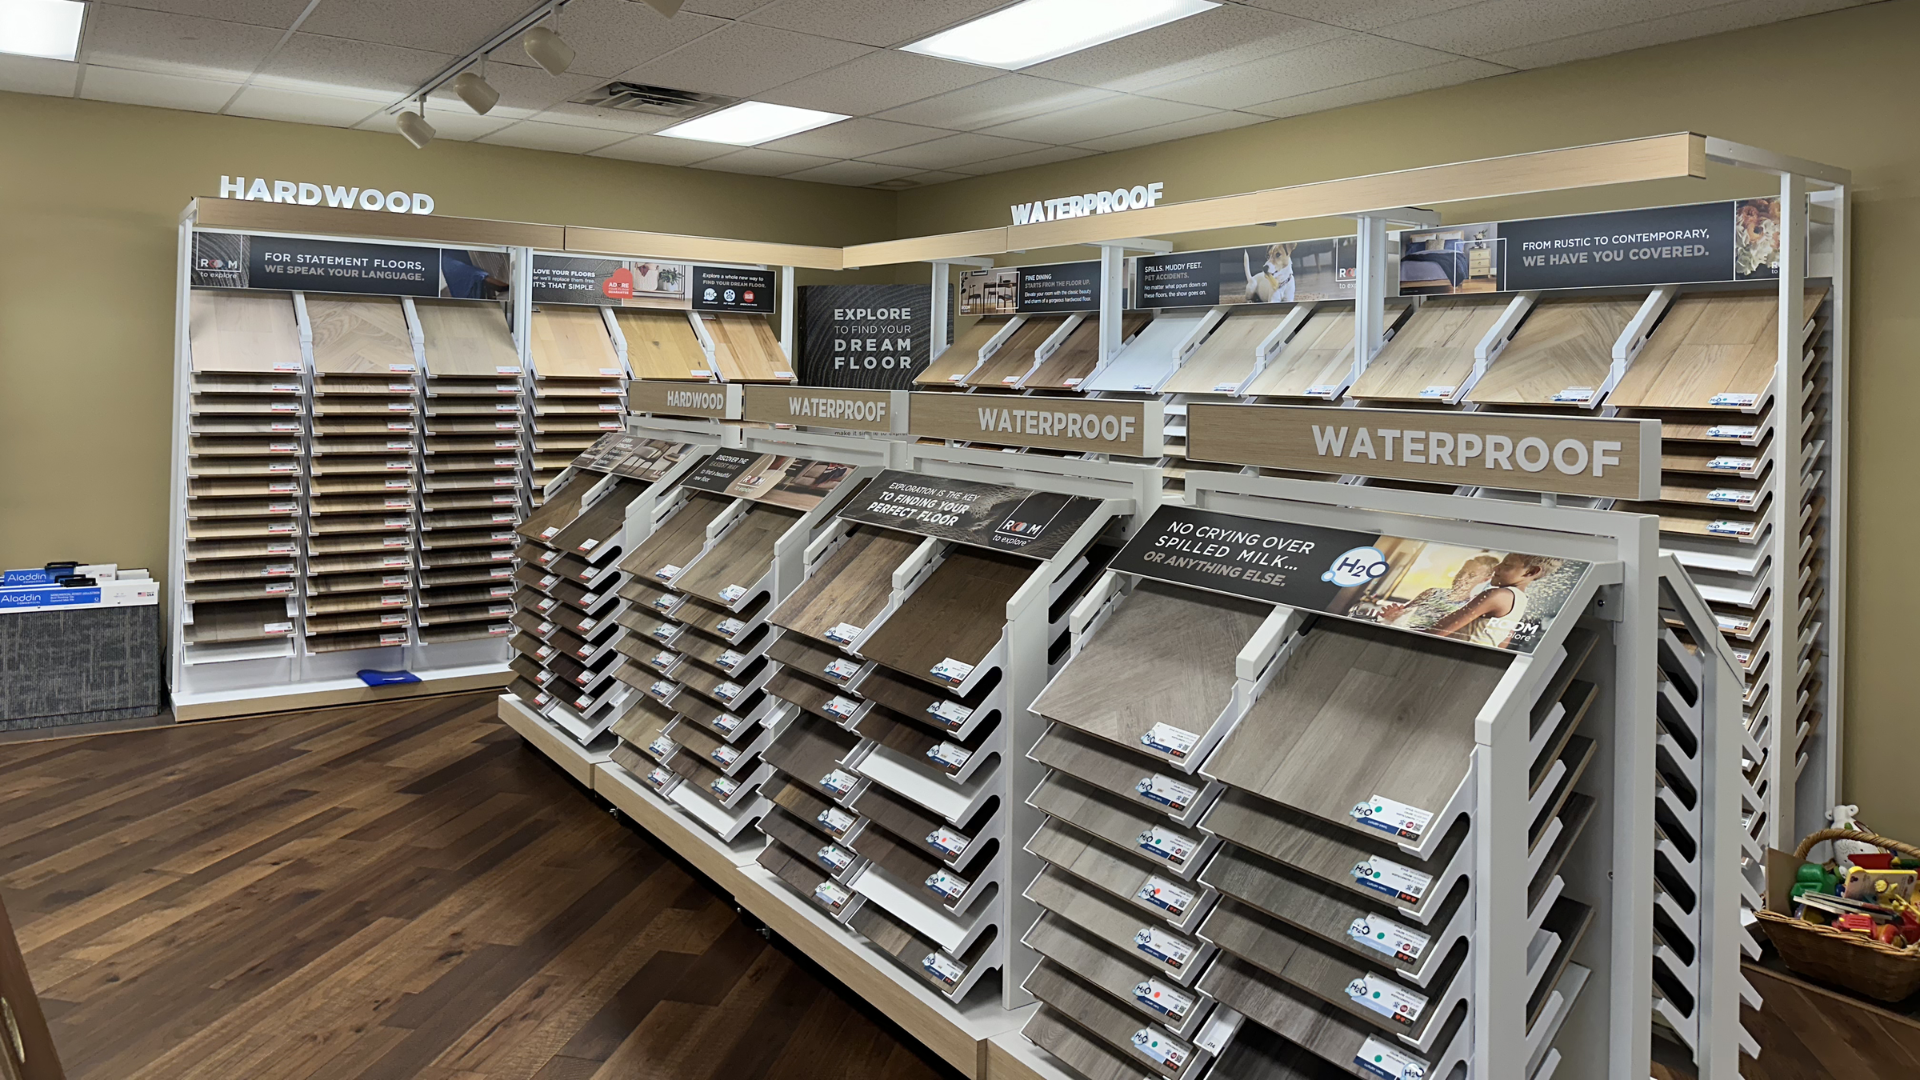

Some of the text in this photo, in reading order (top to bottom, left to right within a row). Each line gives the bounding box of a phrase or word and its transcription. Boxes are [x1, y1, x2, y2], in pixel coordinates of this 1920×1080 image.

[220, 176, 434, 215] HARDWOOD
[1011, 182, 1164, 226] WATERPROOF
[1523, 229, 1710, 251] FROM RUSTIC TO CONTEMPORARY,
[265, 252, 425, 271] FOR STATEMENT FLOORS,
[1523, 244, 1709, 267] WE HAVE YOU COVERED.
[265, 265, 424, 281] WE SPEAK YOUR LANGUAGE.
[834, 308, 911, 320] EXPLORE
[835, 325, 911, 334] TO FIND YOUR
[834, 338, 911, 351] DREAM
[834, 356, 911, 369] FLOOR
[667, 390, 723, 410] HARDWOOD
[789, 396, 886, 422] WATERPROOF
[978, 407, 1135, 442] WATERPROOF
[1311, 425, 1622, 477] WATERPROOF
[888, 482, 936, 497] EXPLORATION
[946, 490, 962, 500] THE
[962, 493, 980, 502] KEY
[878, 492, 970, 515] TO FINDING YOUR
[866, 501, 959, 526] PERFECT FLOOR
[1166, 521, 1316, 555] NO CRYING OVER
[1155, 535, 1298, 571] SPILLED MILK...
[1143, 550, 1286, 587] OR ANYTHING ELSE.
[1336, 556, 1390, 579] H2O
[8, 573, 46, 581] Aladdin
[1, 594, 41, 602] Aladdin
[1354, 806, 1373, 816] H2O
[1140, 834, 1153, 842] H2O
[1355, 865, 1373, 876] H2O
[1142, 888, 1155, 898] H2O
[1138, 932, 1151, 943] H2O
[1136, 985, 1151, 995] H2O
[1351, 983, 1367, 995] H2O
[1135, 1033, 1148, 1043] H2O
[1405, 1067, 1424, 1078] H2O
